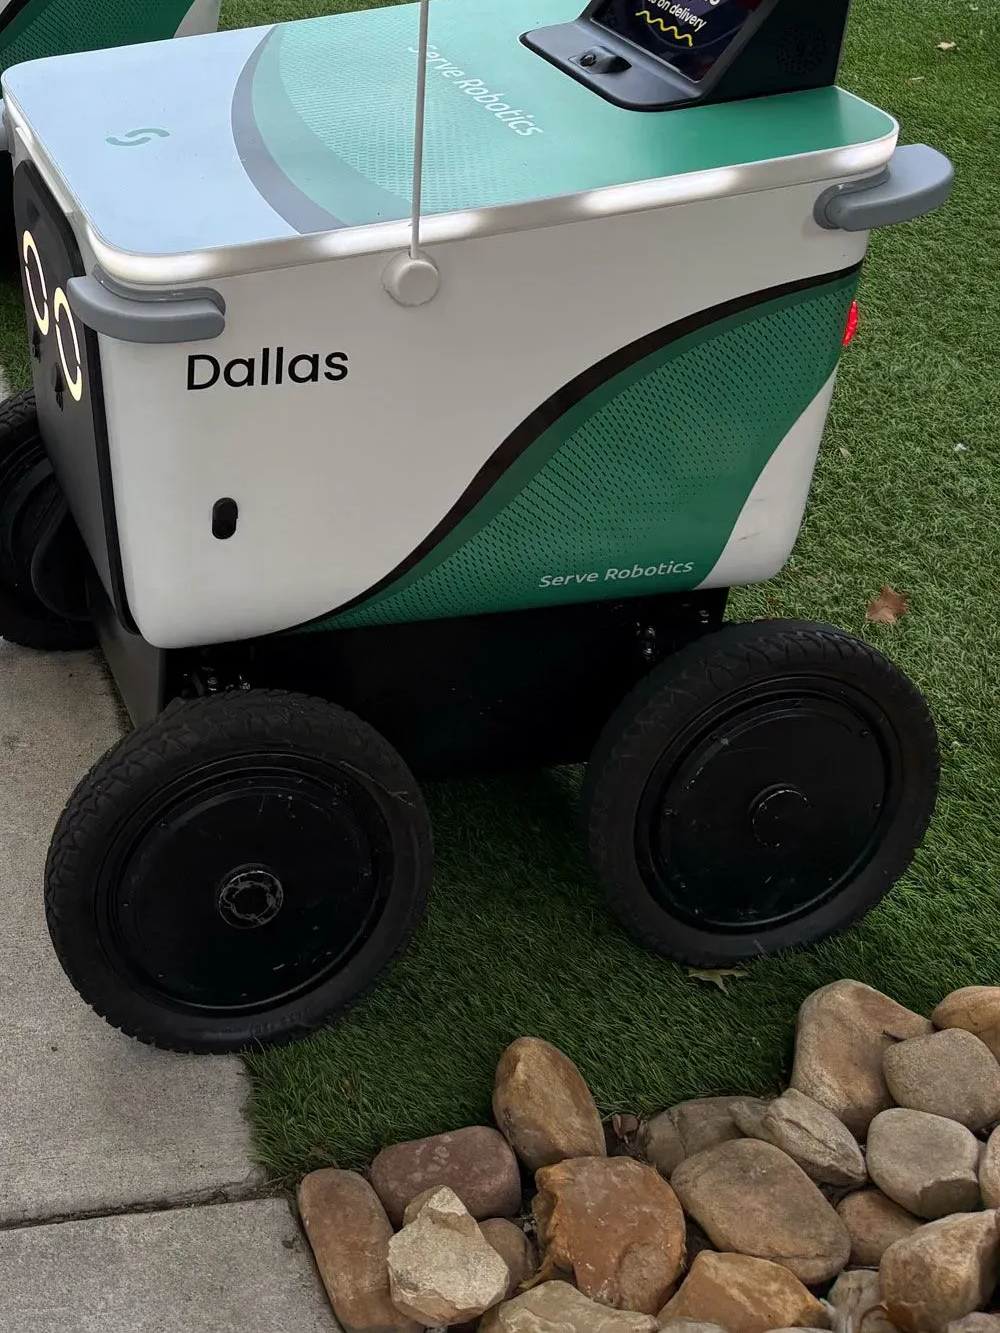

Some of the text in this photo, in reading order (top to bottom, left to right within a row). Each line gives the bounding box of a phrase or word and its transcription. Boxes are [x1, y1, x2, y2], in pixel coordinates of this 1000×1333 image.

[669, 3, 707, 32] delivery
[453, 78, 544, 136] Robotics
[187, 346, 348, 390] Dallas
[538, 560, 695, 588] Serve Robotics
